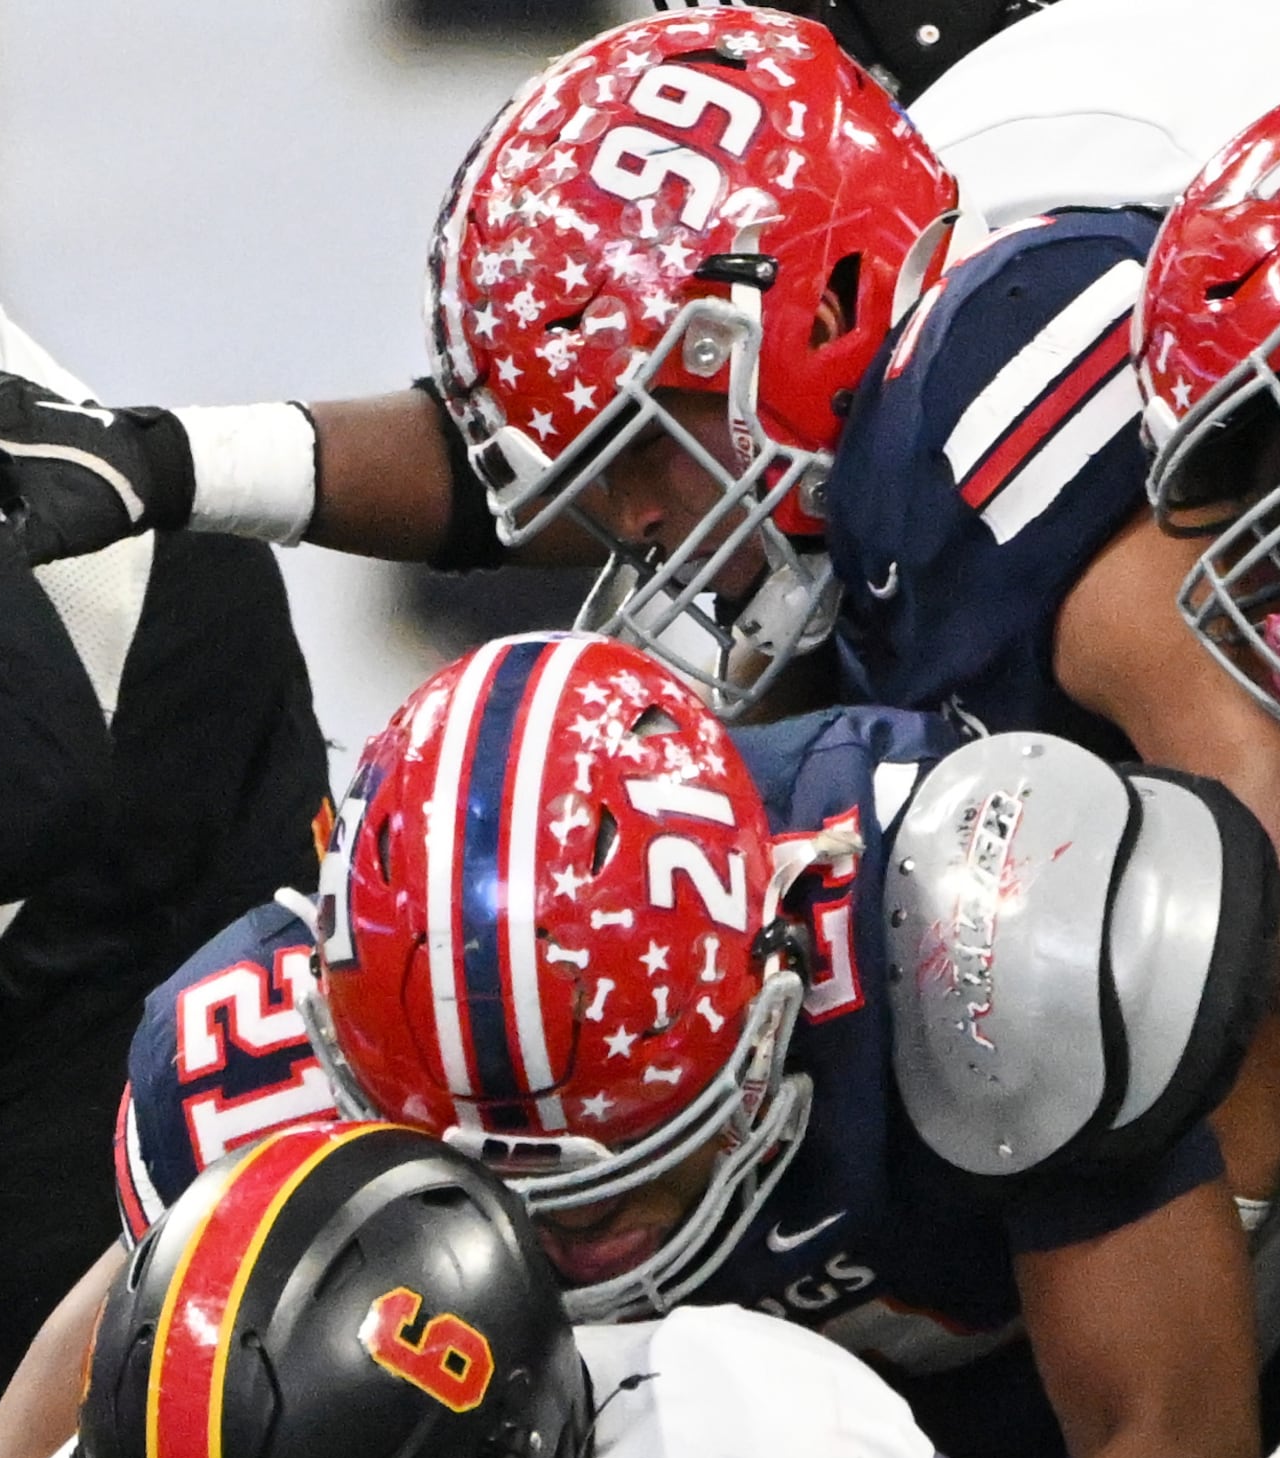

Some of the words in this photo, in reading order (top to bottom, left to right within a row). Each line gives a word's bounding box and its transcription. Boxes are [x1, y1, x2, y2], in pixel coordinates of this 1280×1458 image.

[587, 62, 764, 232] 99
[623, 772, 749, 934] 21
[176, 944, 339, 1174] 21
[357, 1286, 494, 1413] 6
